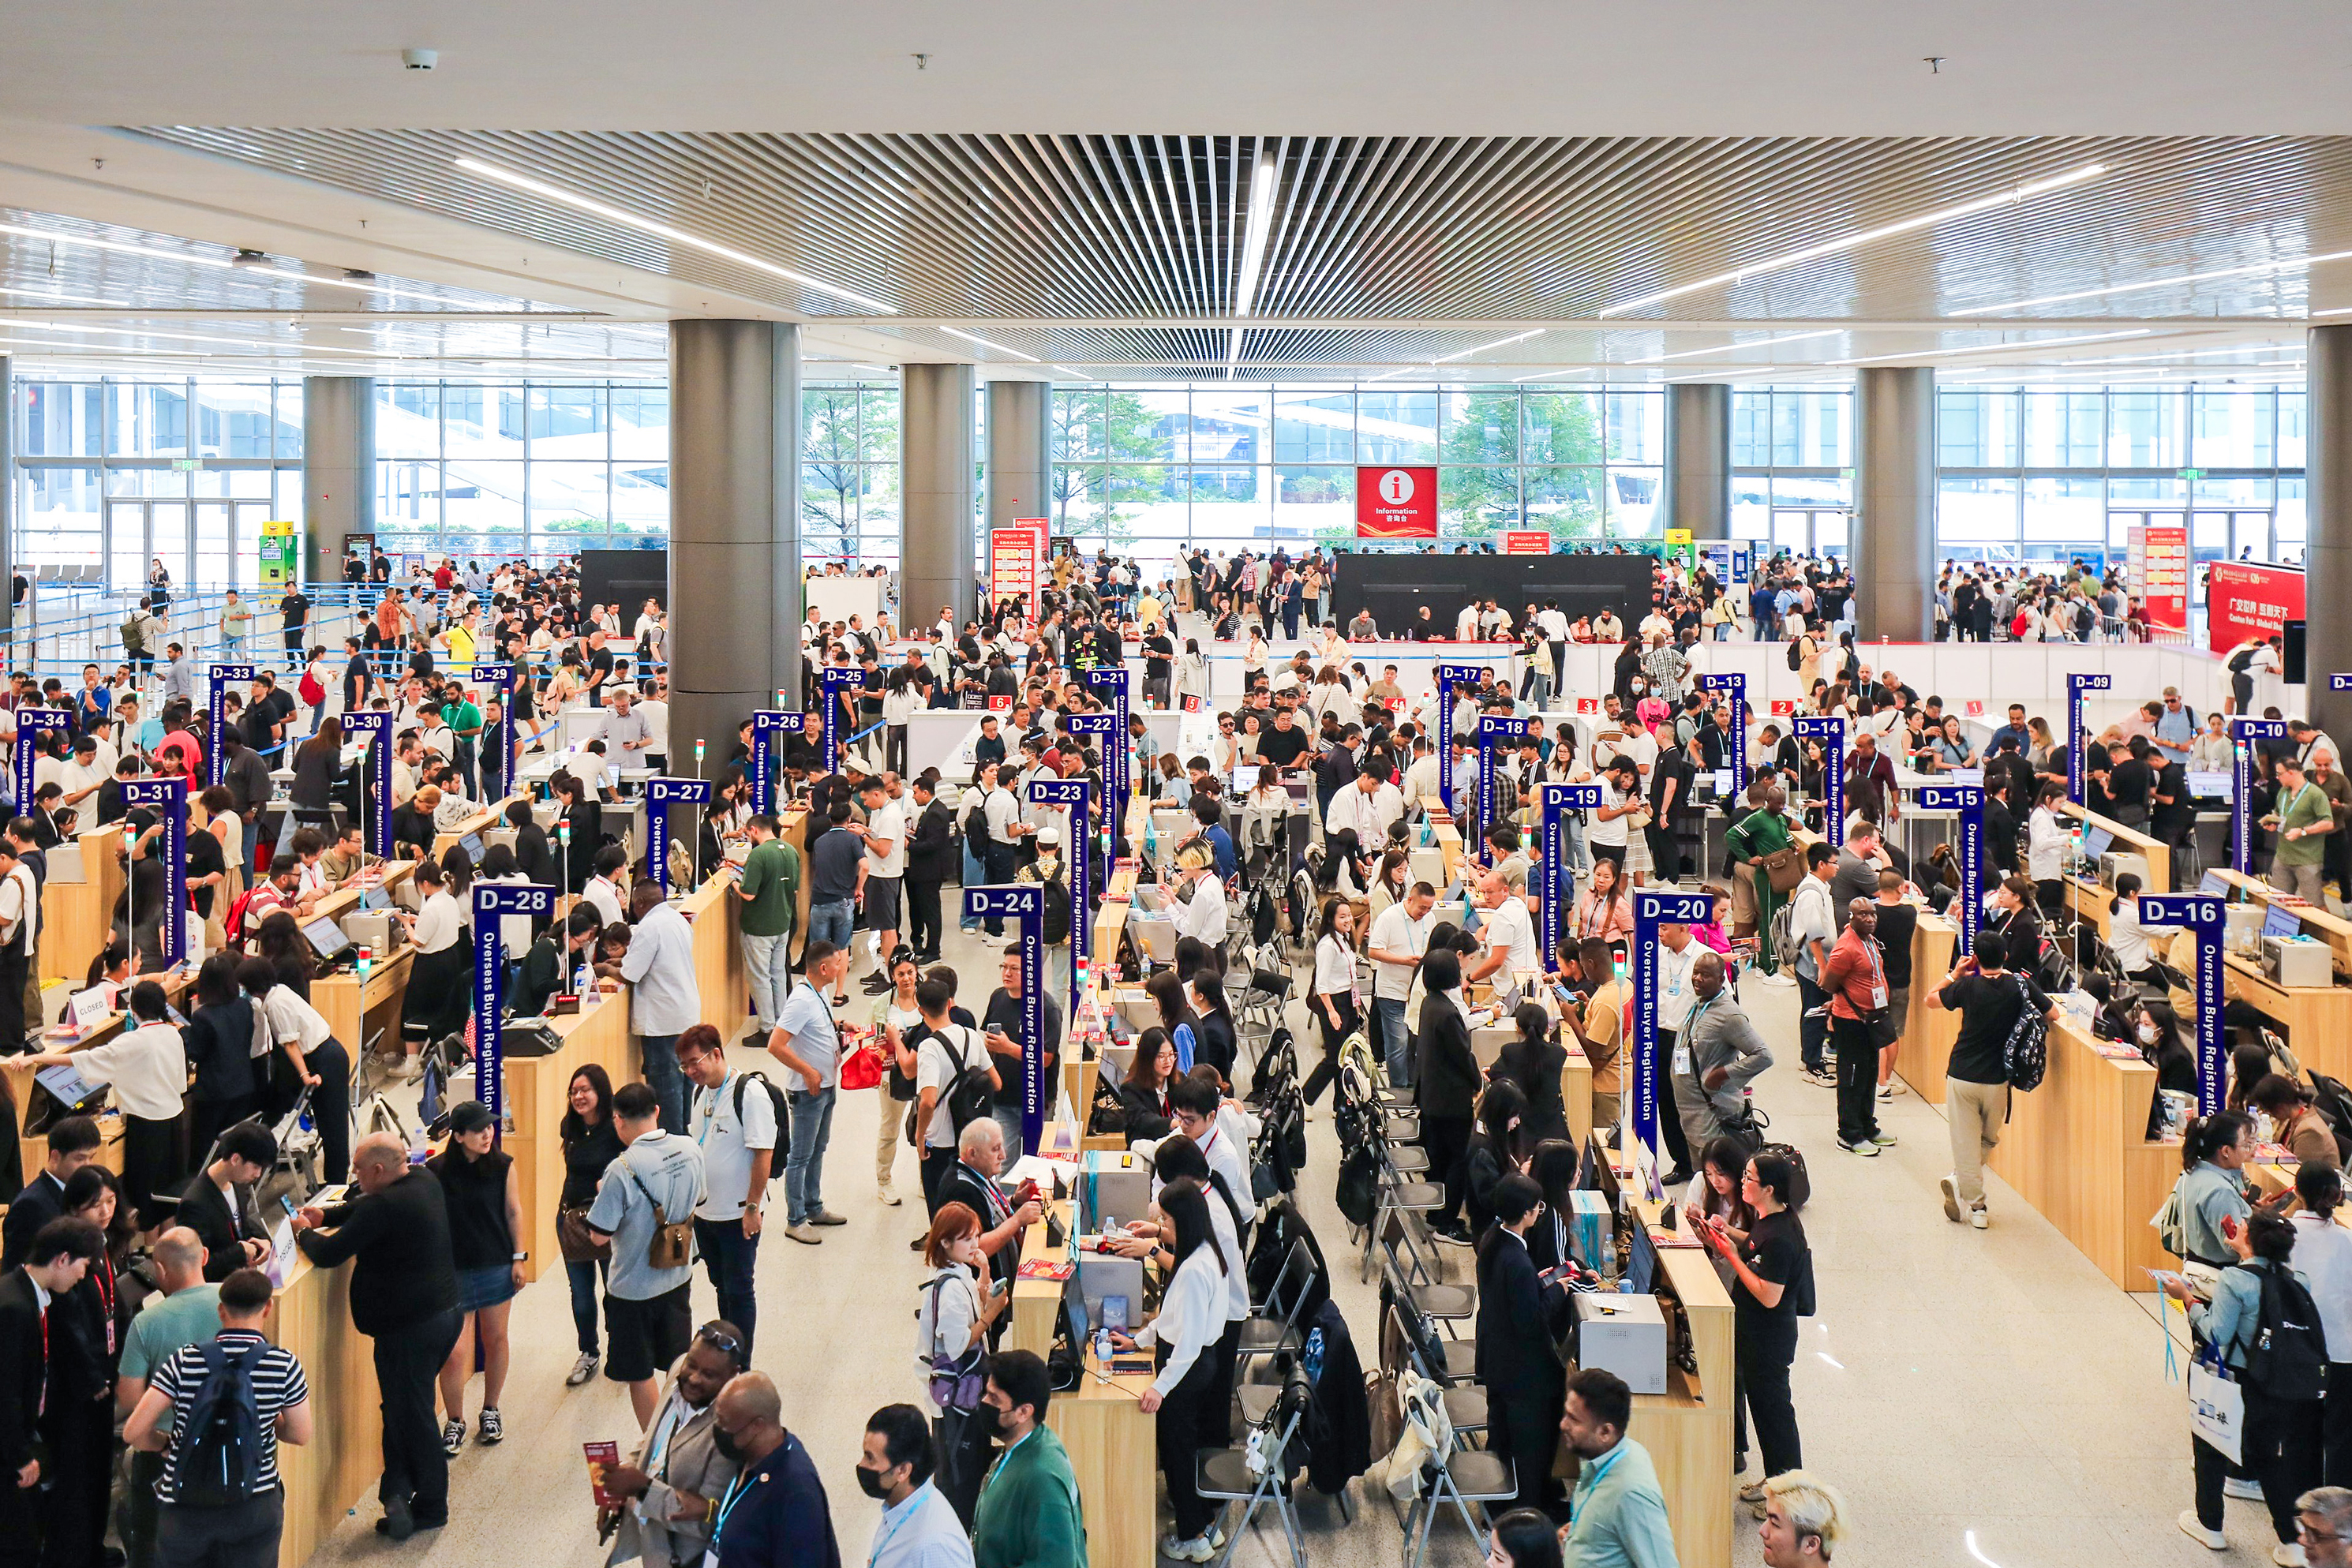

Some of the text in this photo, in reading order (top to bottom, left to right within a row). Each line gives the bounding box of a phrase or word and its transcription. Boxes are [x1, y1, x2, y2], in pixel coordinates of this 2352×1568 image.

[2230, 597, 2289, 620] 广交世界 互利天下
[2230, 613, 2245, 624] Canton
[2257, 618, 2273, 629] Global
[212, 668, 249, 679] D-33
[475, 669, 507, 679] D-29
[827, 670, 861, 682] D-25
[1092, 673, 1124, 683] D-21
[1444, 668, 1477, 680] D-17
[1707, 676, 1741, 687] D-13
[2077, 676, 2108, 687] D-09
[2334, 676, 2352, 688] D-
[997, 698, 1004, 708] 6
[1189, 698, 1195, 709] 5
[1391, 699, 1399, 709] 4
[1779, 702, 1787, 713] 2
[1972, 702, 1978, 712] 1
[21, 713, 66, 727] D-34
[345, 716, 381, 728] D-30
[758, 715, 799, 728] D-26
[1073, 718, 1111, 731] D-22
[1484, 719, 1524, 734] D-18
[1798, 721, 1839, 734] D-14
[2245, 723, 2283, 736] D-10
[22, 740, 31, 777] Overseas
[758, 742, 766, 779] Overseas
[21, 778, 30, 803] Buyer
[127, 785, 172, 800] D-31
[654, 785, 703, 800] D-27
[757, 780, 766, 803] Buyer
[1035, 784, 1080, 800] D-23
[1482, 784, 1491, 808] Buyer
[1549, 789, 1596, 804] D-19
[1927, 790, 1977, 805] D-15
[1830, 810, 1839, 848] Registrat
[654, 816, 663, 883] Overseas Buy
[1074, 865, 1083, 894] Buyer
[1548, 870, 1557, 899] Buyer
[1966, 823, 1977, 957] Overseas Buyer Registratio
[481, 890, 545, 909] D-28
[973, 893, 1034, 911] D-24
[1644, 899, 1705, 919] D-20
[2147, 901, 2215, 922] D-16
[1073, 896, 1083, 956] Registration
[1548, 900, 1557, 961] Registration
[483, 932, 495, 990] Overseas
[80, 1001, 103, 1016] CLOSED
[482, 993, 495, 1031] Buyer
[1026, 935, 1036, 1113] Overseas Buyer Registration
[1642, 941, 1654, 1121] Overseas Buyer Registration
[2203, 945, 2217, 1117] Overseas Buyer Registratio
